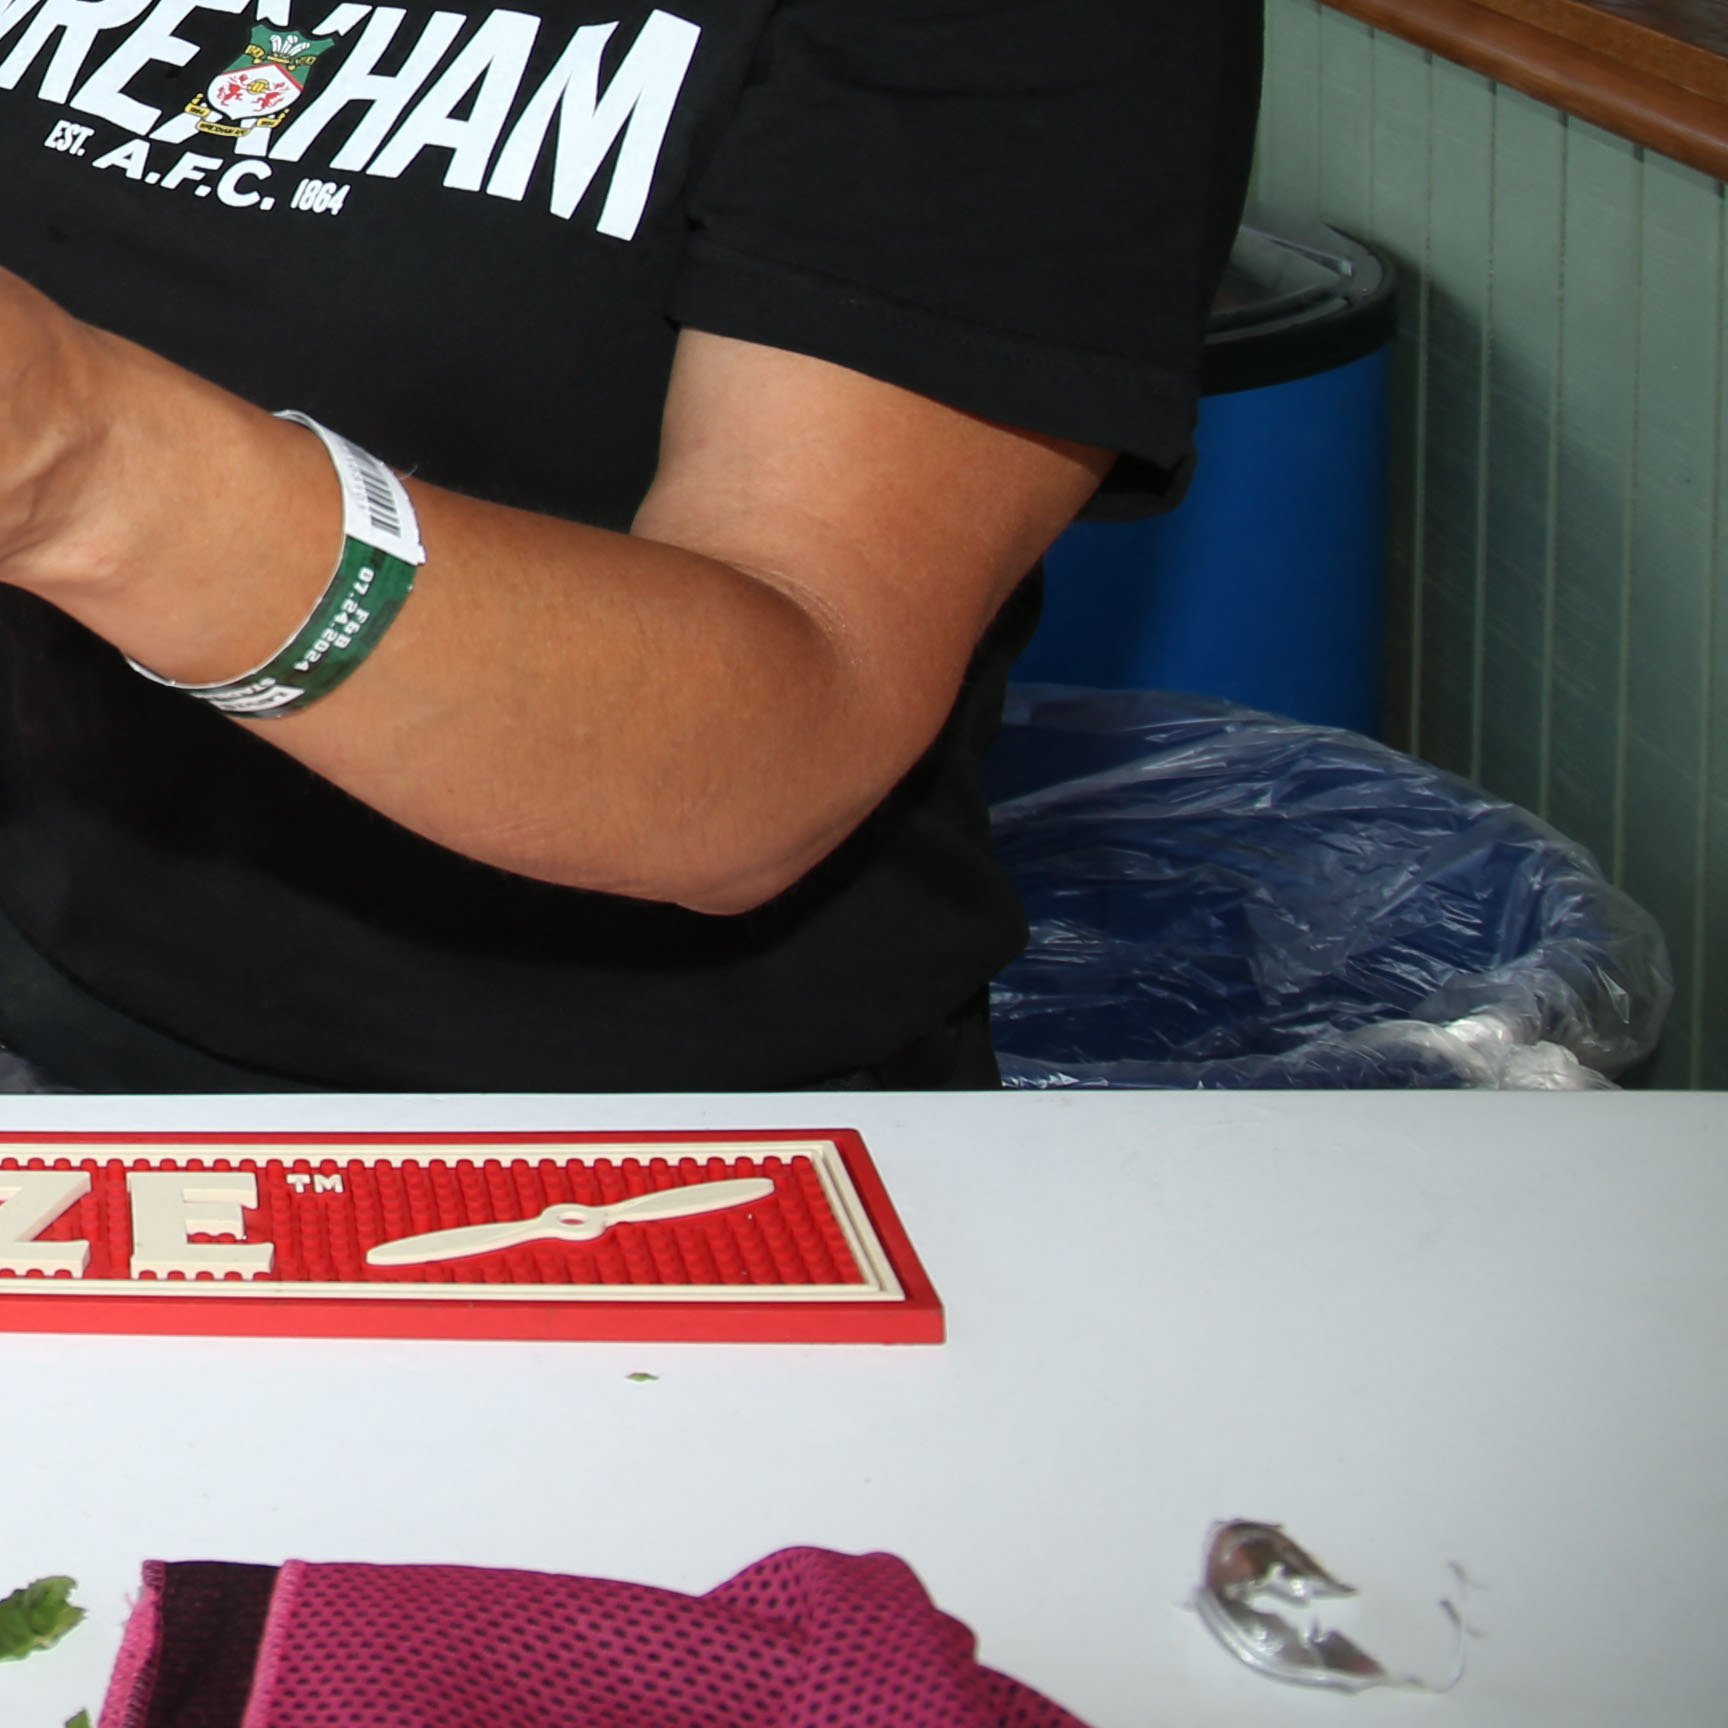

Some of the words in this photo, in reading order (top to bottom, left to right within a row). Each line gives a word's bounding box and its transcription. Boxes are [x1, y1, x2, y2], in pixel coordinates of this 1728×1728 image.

[44, 119, 94, 157] EST.
[91, 138, 276, 211] A.F.C.
[290, 179, 350, 216] 1864
